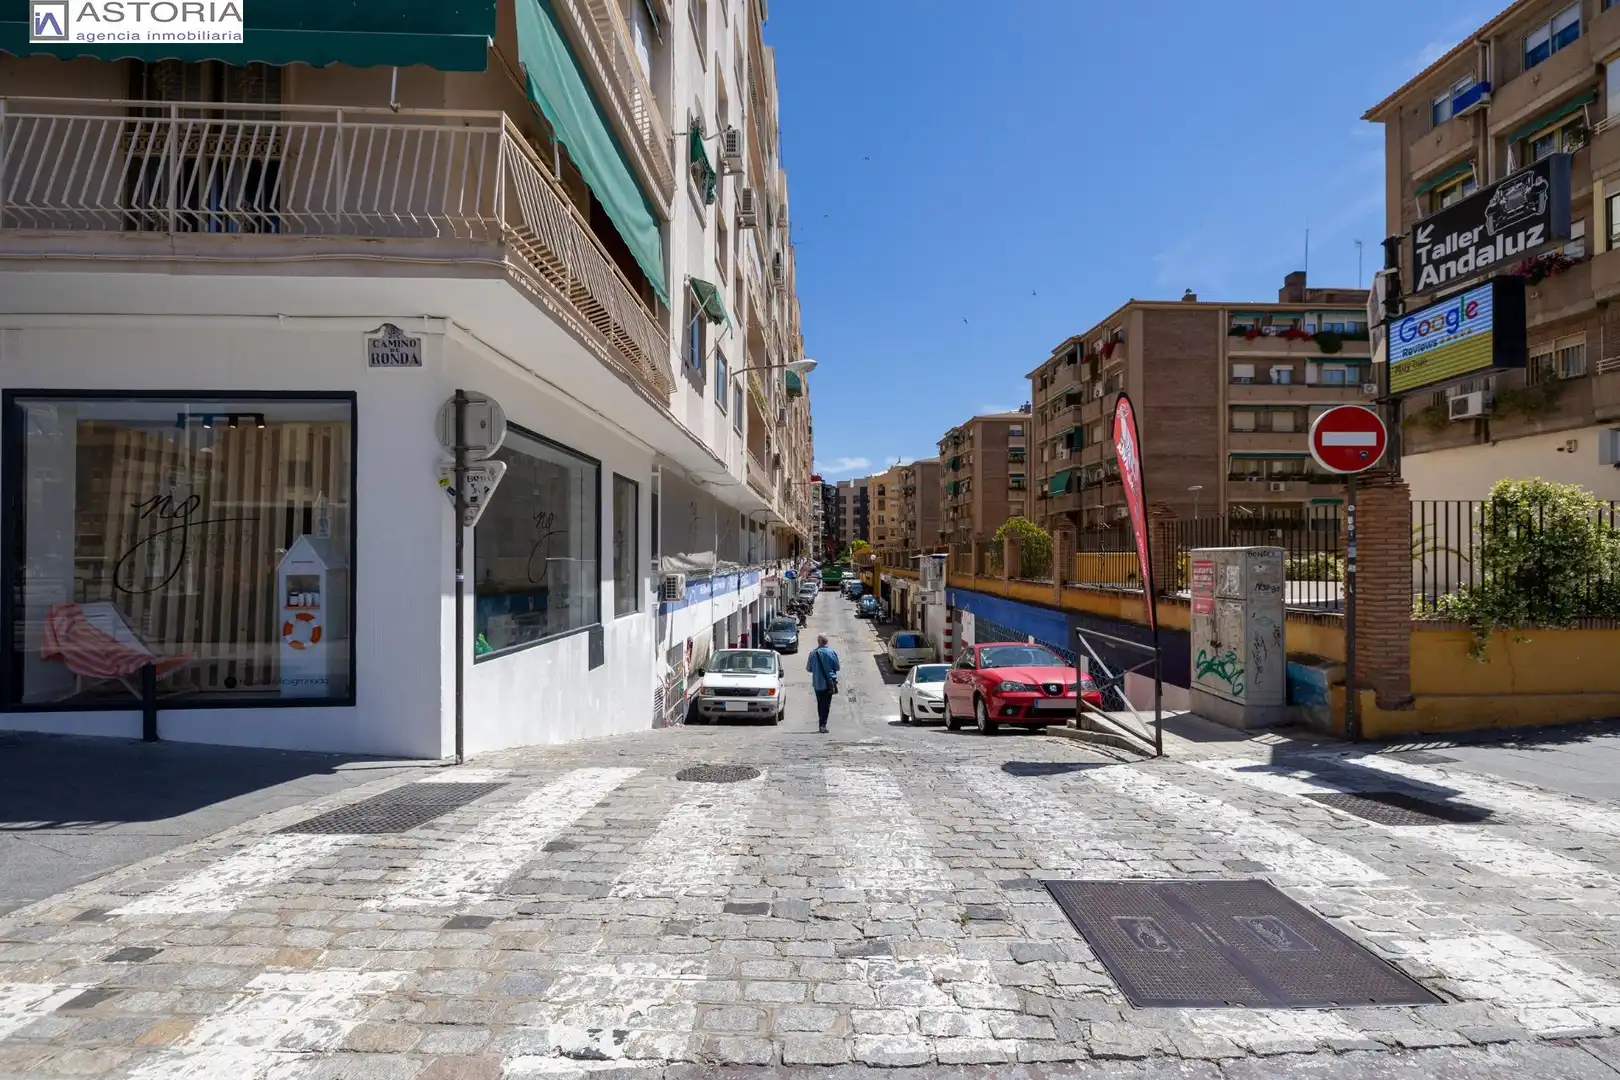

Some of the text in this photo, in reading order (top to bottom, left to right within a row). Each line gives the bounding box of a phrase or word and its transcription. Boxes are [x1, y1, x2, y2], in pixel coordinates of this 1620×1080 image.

[1416, 224, 1484, 265] Taller
[1416, 223, 1545, 292] Andaluz
[1399, 296, 1478, 343] Google
[371, 352, 419, 365] RONDA
[372, 339, 416, 348] CAMINO
[1402, 338, 1438, 358] Reviews
